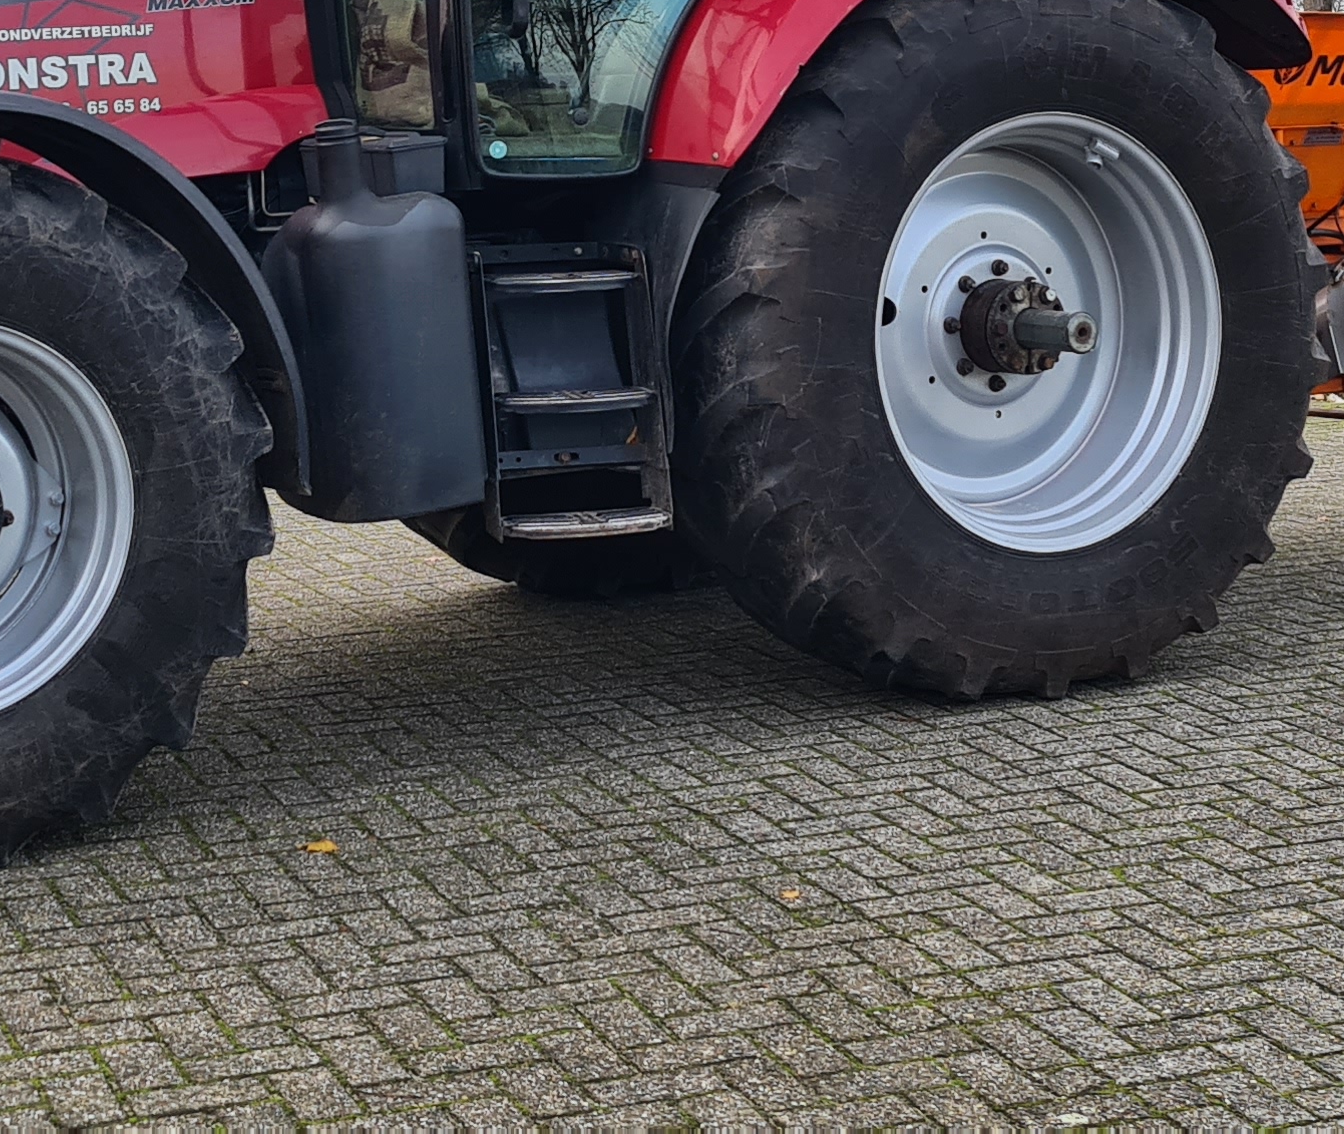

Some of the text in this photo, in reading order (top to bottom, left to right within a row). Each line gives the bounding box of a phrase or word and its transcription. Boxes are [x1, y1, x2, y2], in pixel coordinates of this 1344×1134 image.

[86, 100, 109, 115] 65
[113, 98, 135, 113] 65
[139, 97, 161, 112] 84
